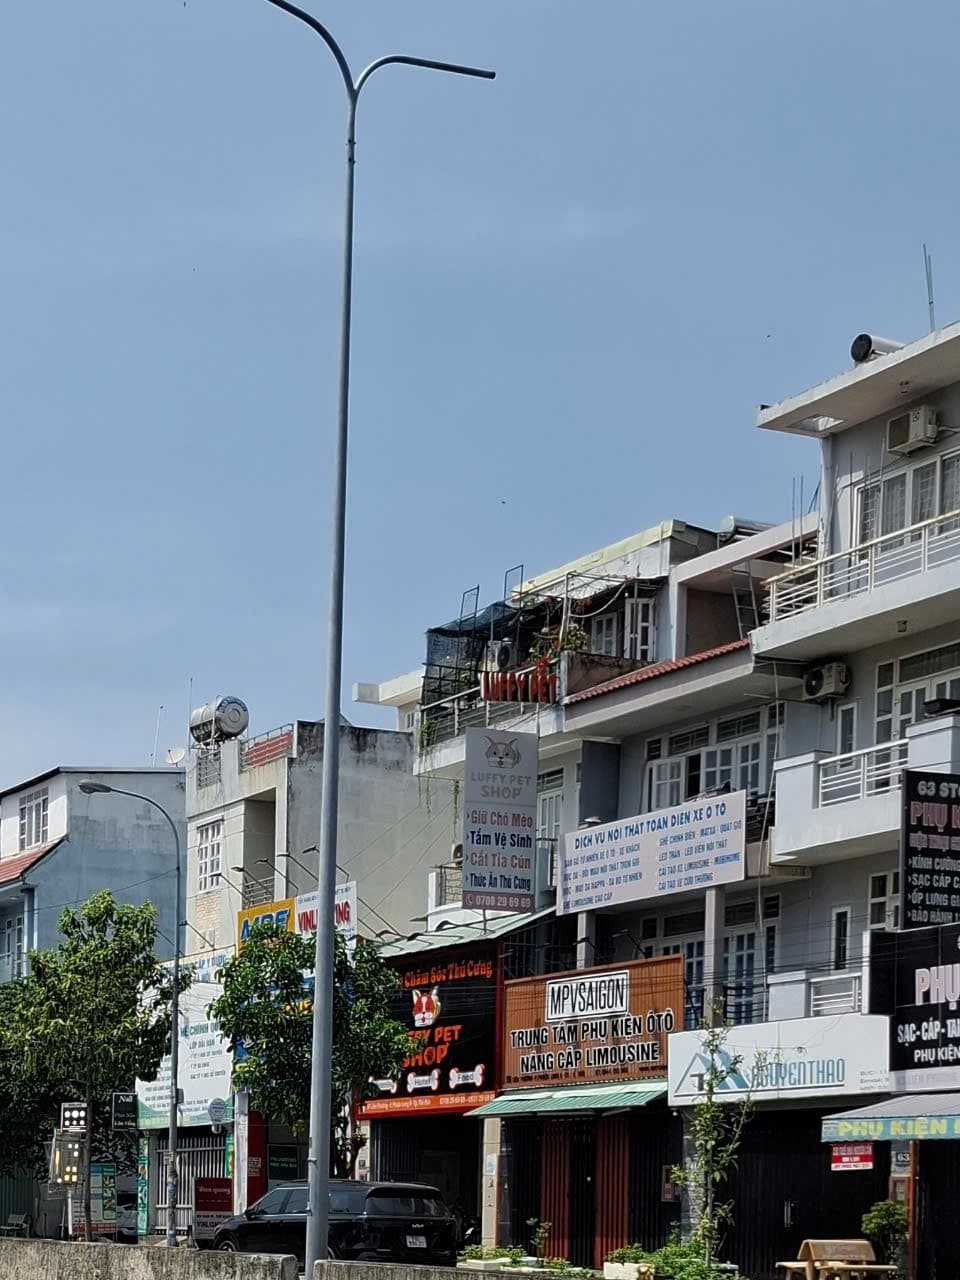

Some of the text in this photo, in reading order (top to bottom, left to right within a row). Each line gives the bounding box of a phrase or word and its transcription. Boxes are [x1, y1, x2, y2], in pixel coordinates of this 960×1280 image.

[480, 671, 525, 702] LUFFY
[471, 771, 531, 786] LUFFY PET
[481, 785, 522, 800] SHOP
[917, 780, 960, 799] 63 ST
[490, 811, 509, 826] Chó
[511, 812, 533, 828] Mèo
[693, 807, 703, 821] XE
[910, 801, 948, 832] PHỤ
[495, 832, 507, 849] Vệ
[510, 833, 532, 848] Sinh
[511, 853, 531, 869] Cún
[912, 873, 930, 889] SẠC
[933, 872, 951, 888] CÁP
[447, 959, 466, 980] Thú
[915, 963, 960, 1010] PHỤ
[550, 978, 625, 1016] MPVSAIGON
[434, 1024, 463, 1042] PET
[511, 1008, 674, 1048] TRUNG TÂM PHỤ KIỆN ÔTÔ
[520, 1049, 554, 1074] NÂNG
[586, 1041, 660, 1067] LIMOUSINE
[913, 1044, 960, 1064] PHỤ KIỆN
[838, 1120, 883, 1140] PHỤ
[890, 1117, 947, 1139] KIỆN
[897, 1153, 910, 1162] 63
